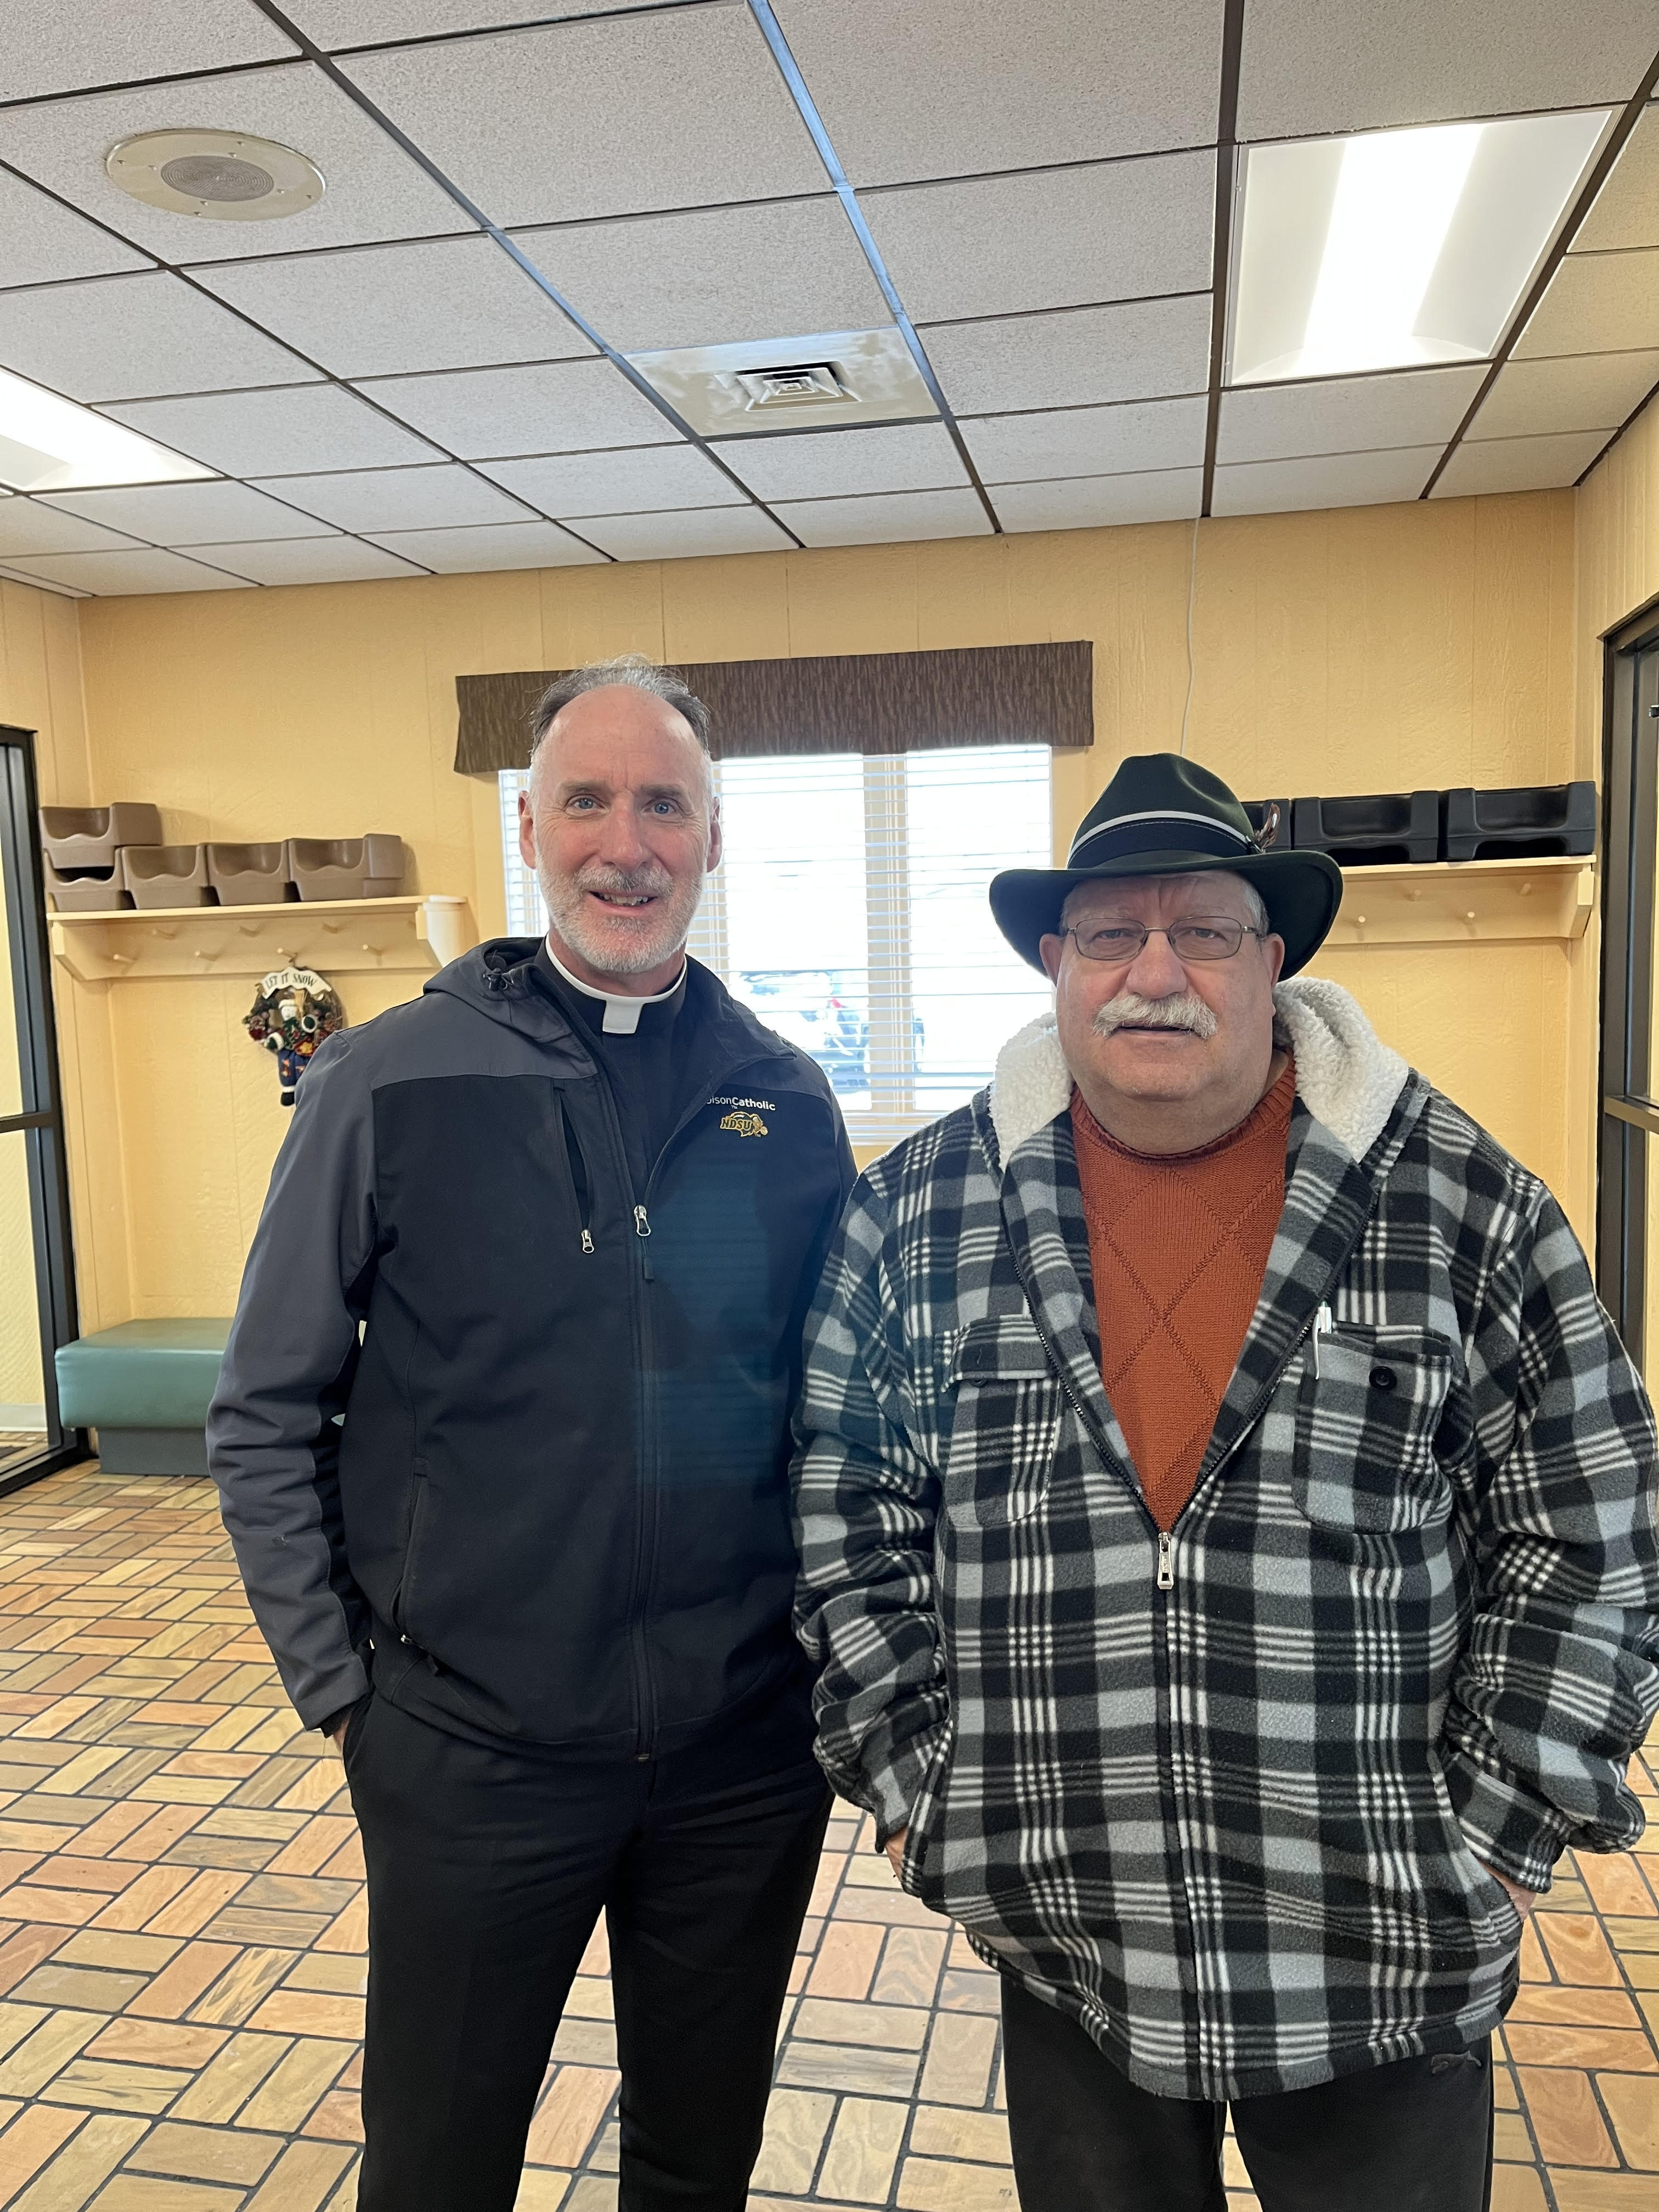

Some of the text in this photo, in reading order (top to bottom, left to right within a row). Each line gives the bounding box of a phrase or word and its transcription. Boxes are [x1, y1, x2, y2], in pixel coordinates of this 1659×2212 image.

[265, 972, 317, 989] LET IT SNOW
[721, 1119, 752, 1130] NDSU
